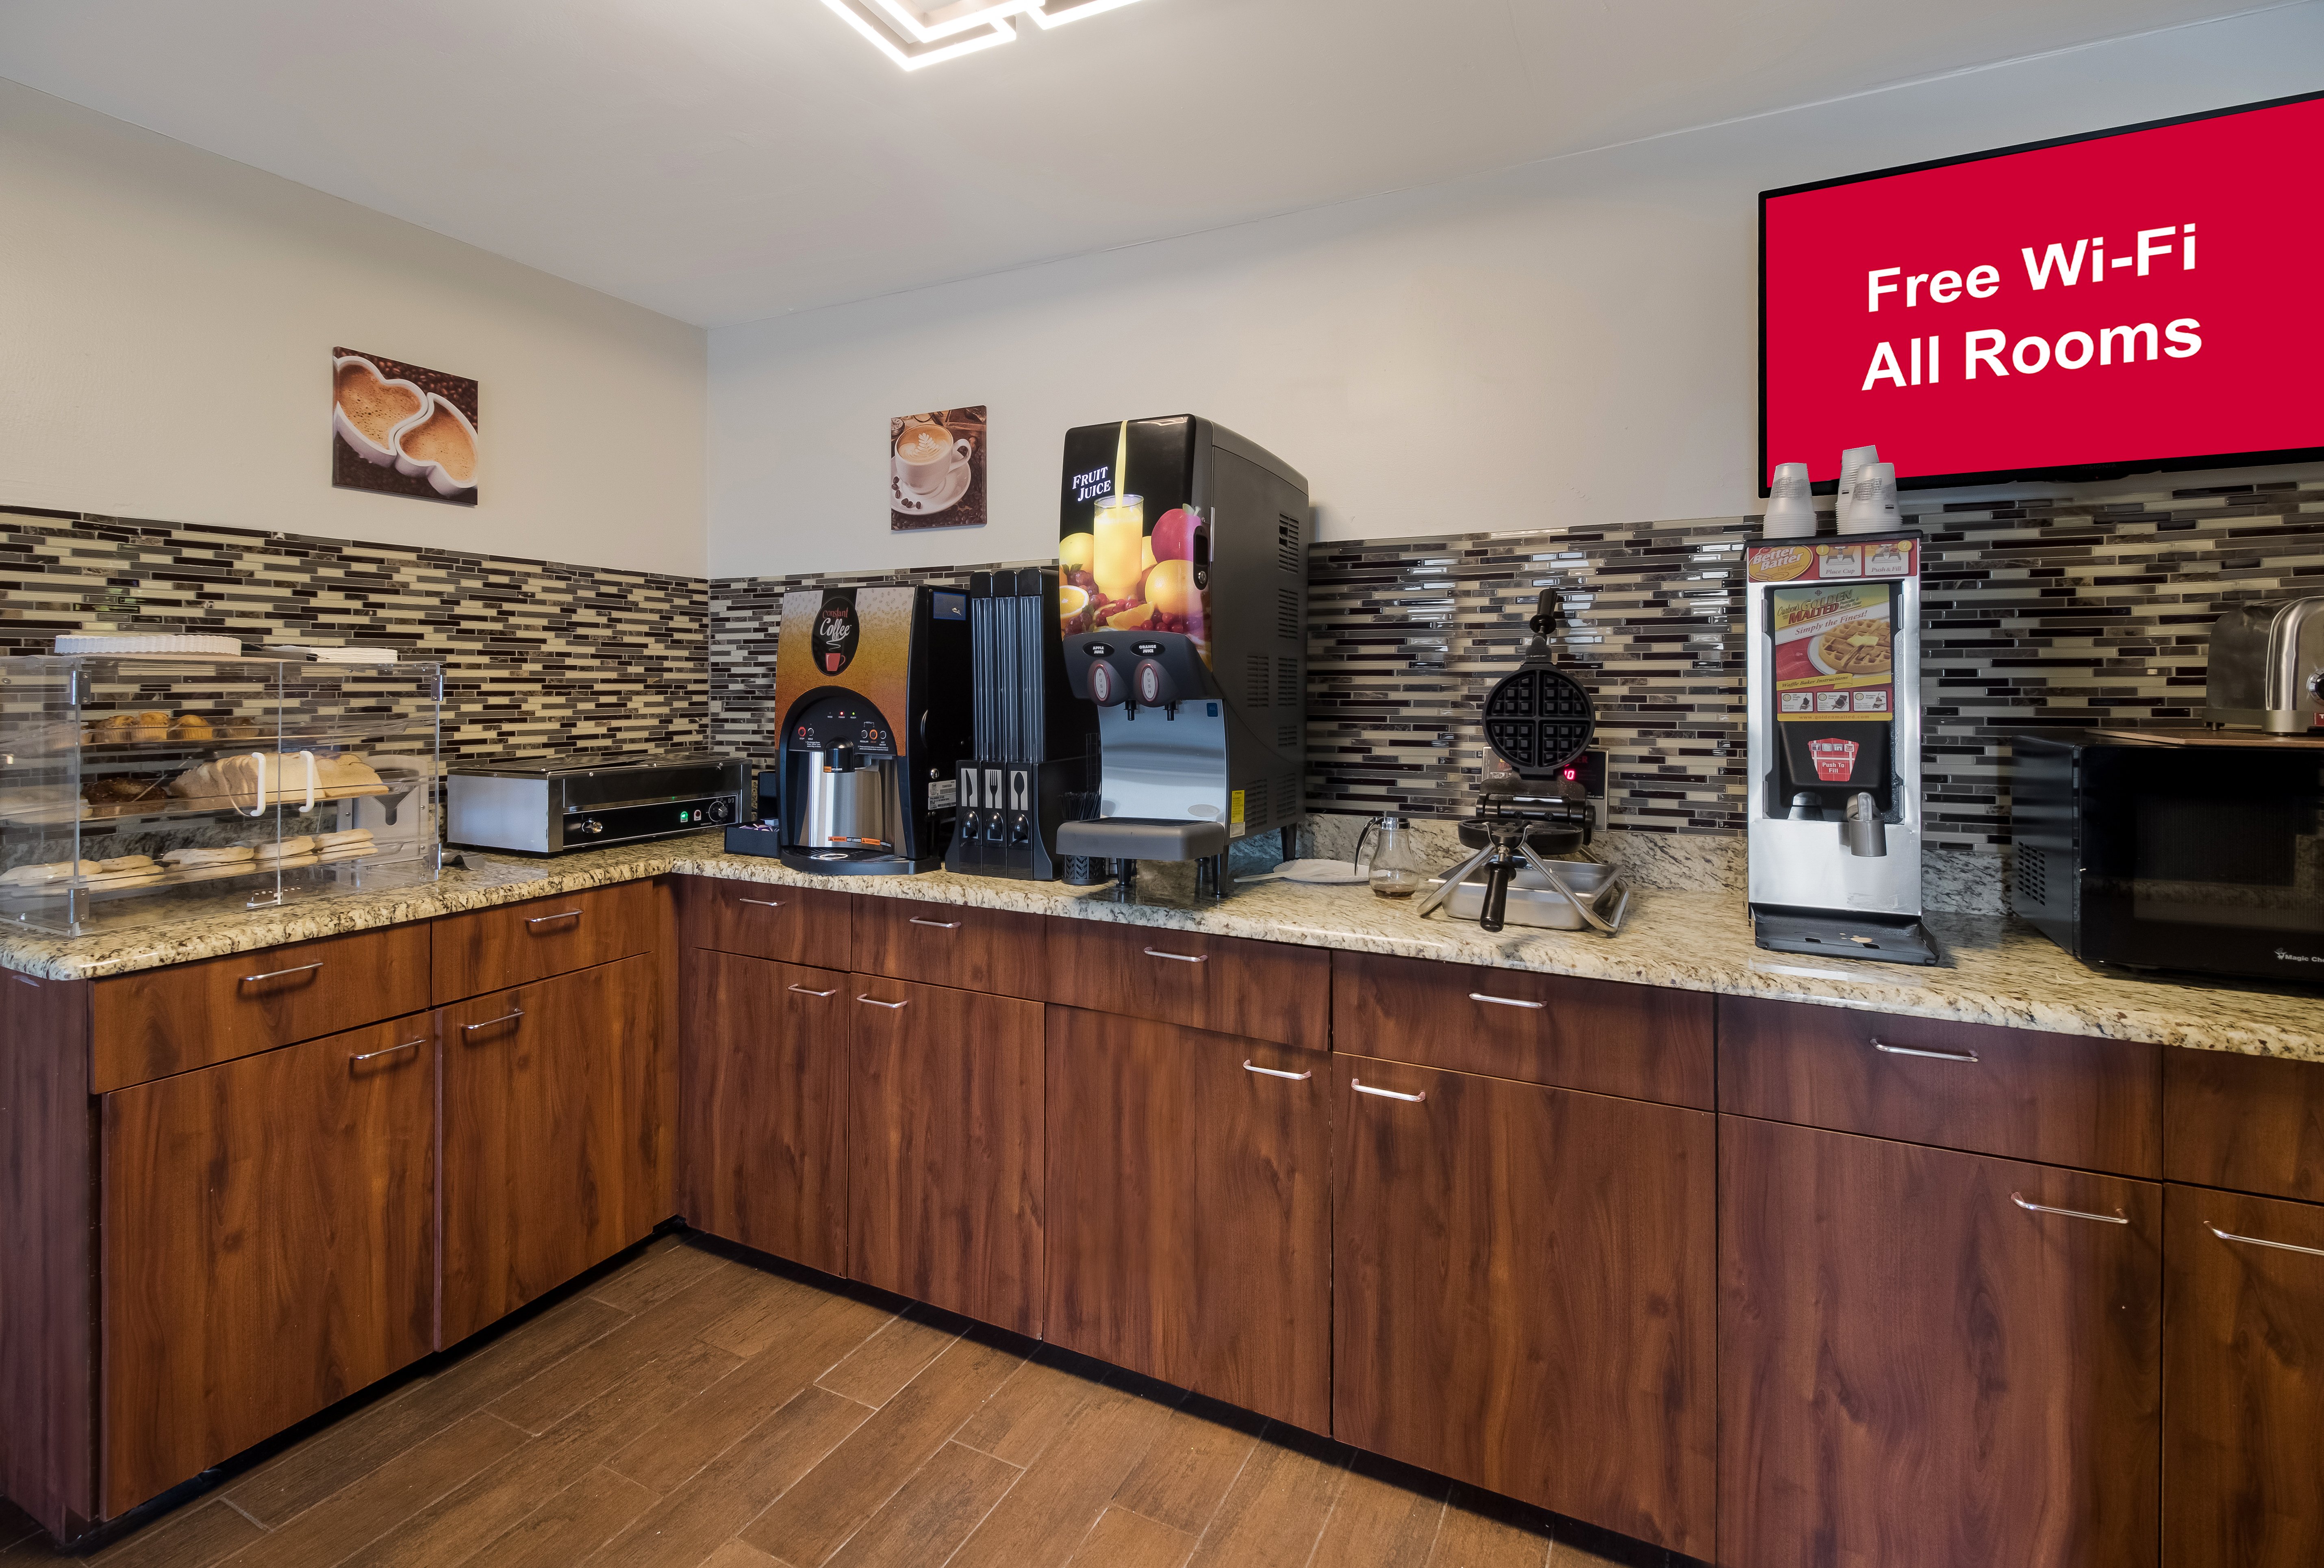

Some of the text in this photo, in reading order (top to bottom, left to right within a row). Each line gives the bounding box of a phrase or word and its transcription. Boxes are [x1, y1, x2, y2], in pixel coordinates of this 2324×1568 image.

[1869, 223, 2195, 312] Free Wi-Fi
[1861, 318, 2202, 391] All Rooms
[1072, 466, 1108, 489] FRUIT
[1077, 480, 1111, 501] JUICE
[1752, 547, 1796, 565] Better
[1760, 552, 1804, 571] Batter
[823, 607, 849, 619] constant
[1777, 589, 1853, 616] Carbon's GOLDEN
[1788, 603, 1839, 624] MALTED
[820, 618, 850, 640] Coffee
[1795, 623, 1823, 635] Simply
[1840, 610, 1868, 623] Finest!
